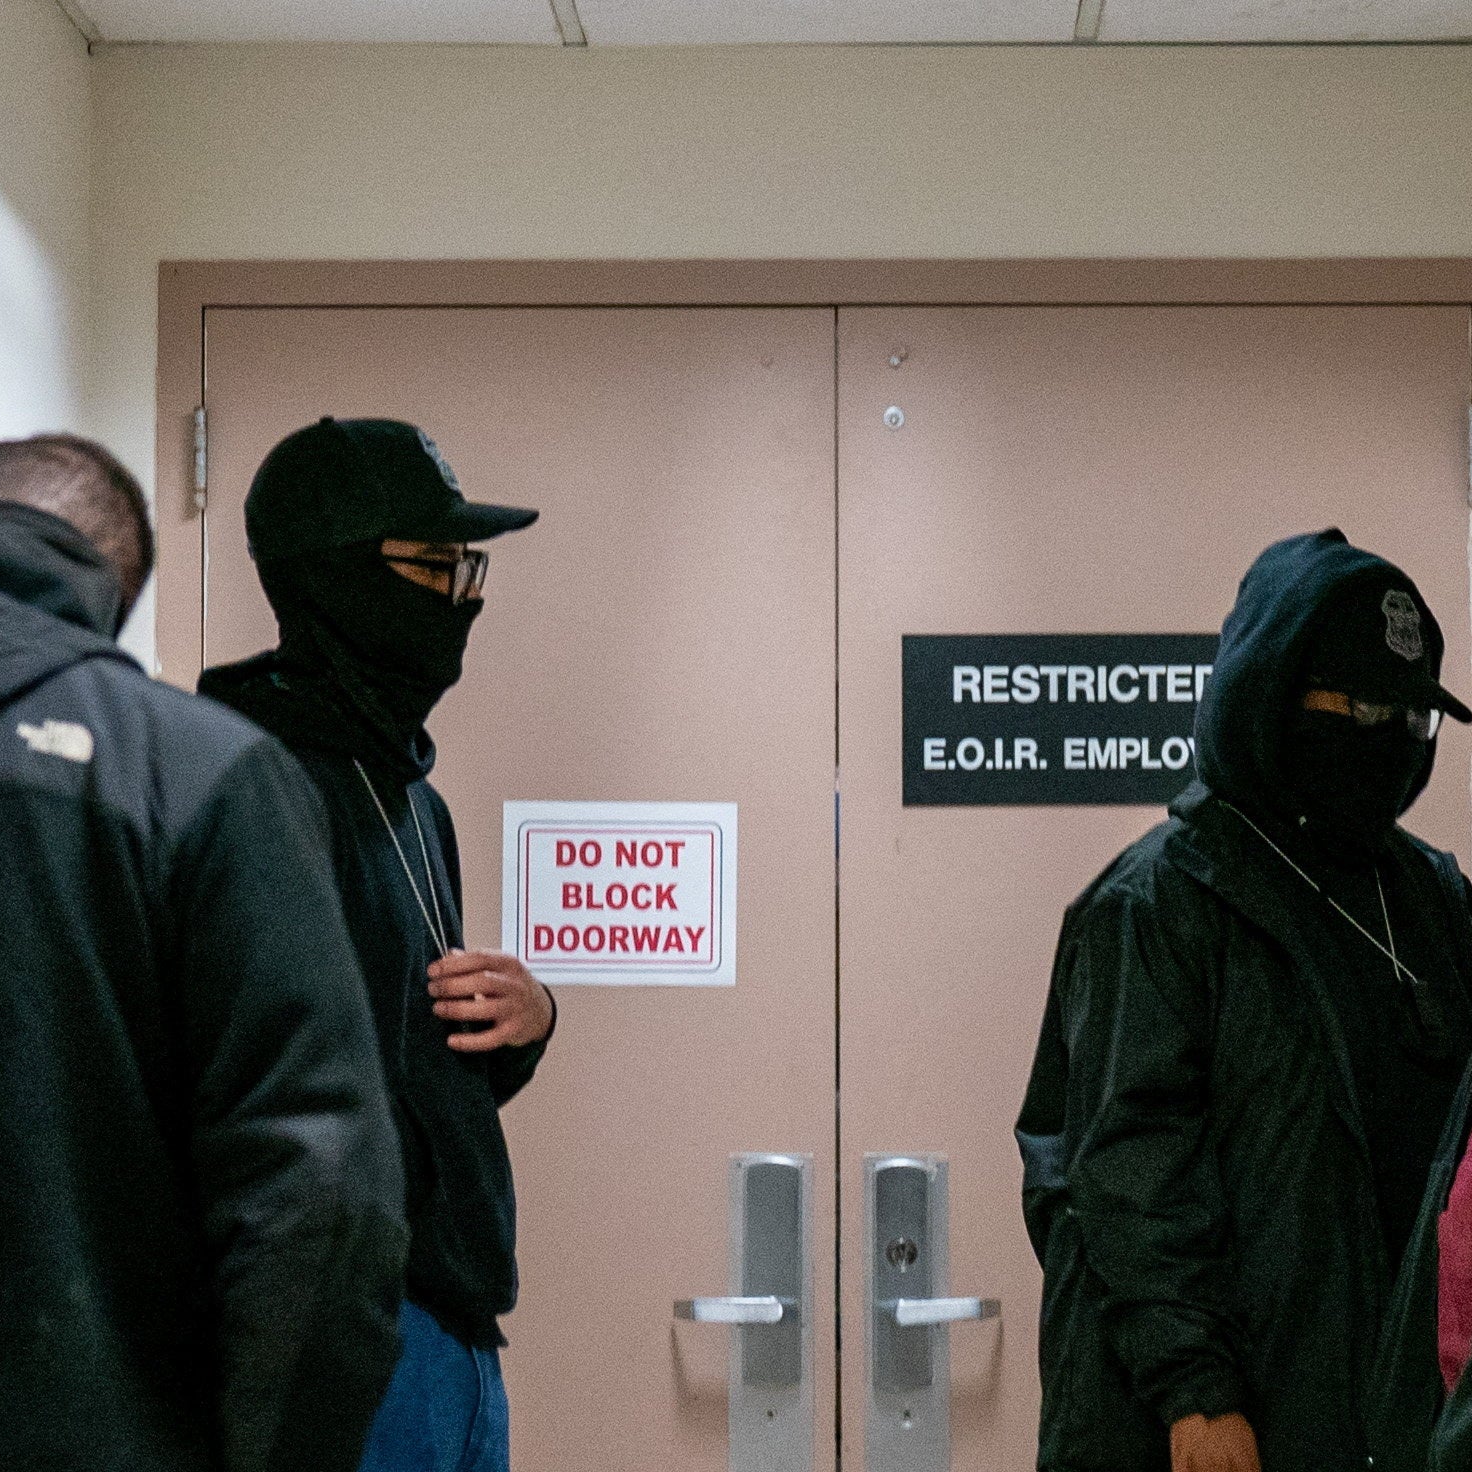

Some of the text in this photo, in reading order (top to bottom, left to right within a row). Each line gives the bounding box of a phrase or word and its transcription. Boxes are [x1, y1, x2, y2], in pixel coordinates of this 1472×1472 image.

[923, 736, 1196, 771] E.O.I.R. EMPLO
[556, 840, 686, 868] DO NOT
[561, 882, 679, 910] BLOCK
[533, 925, 706, 954] DOORWAY
